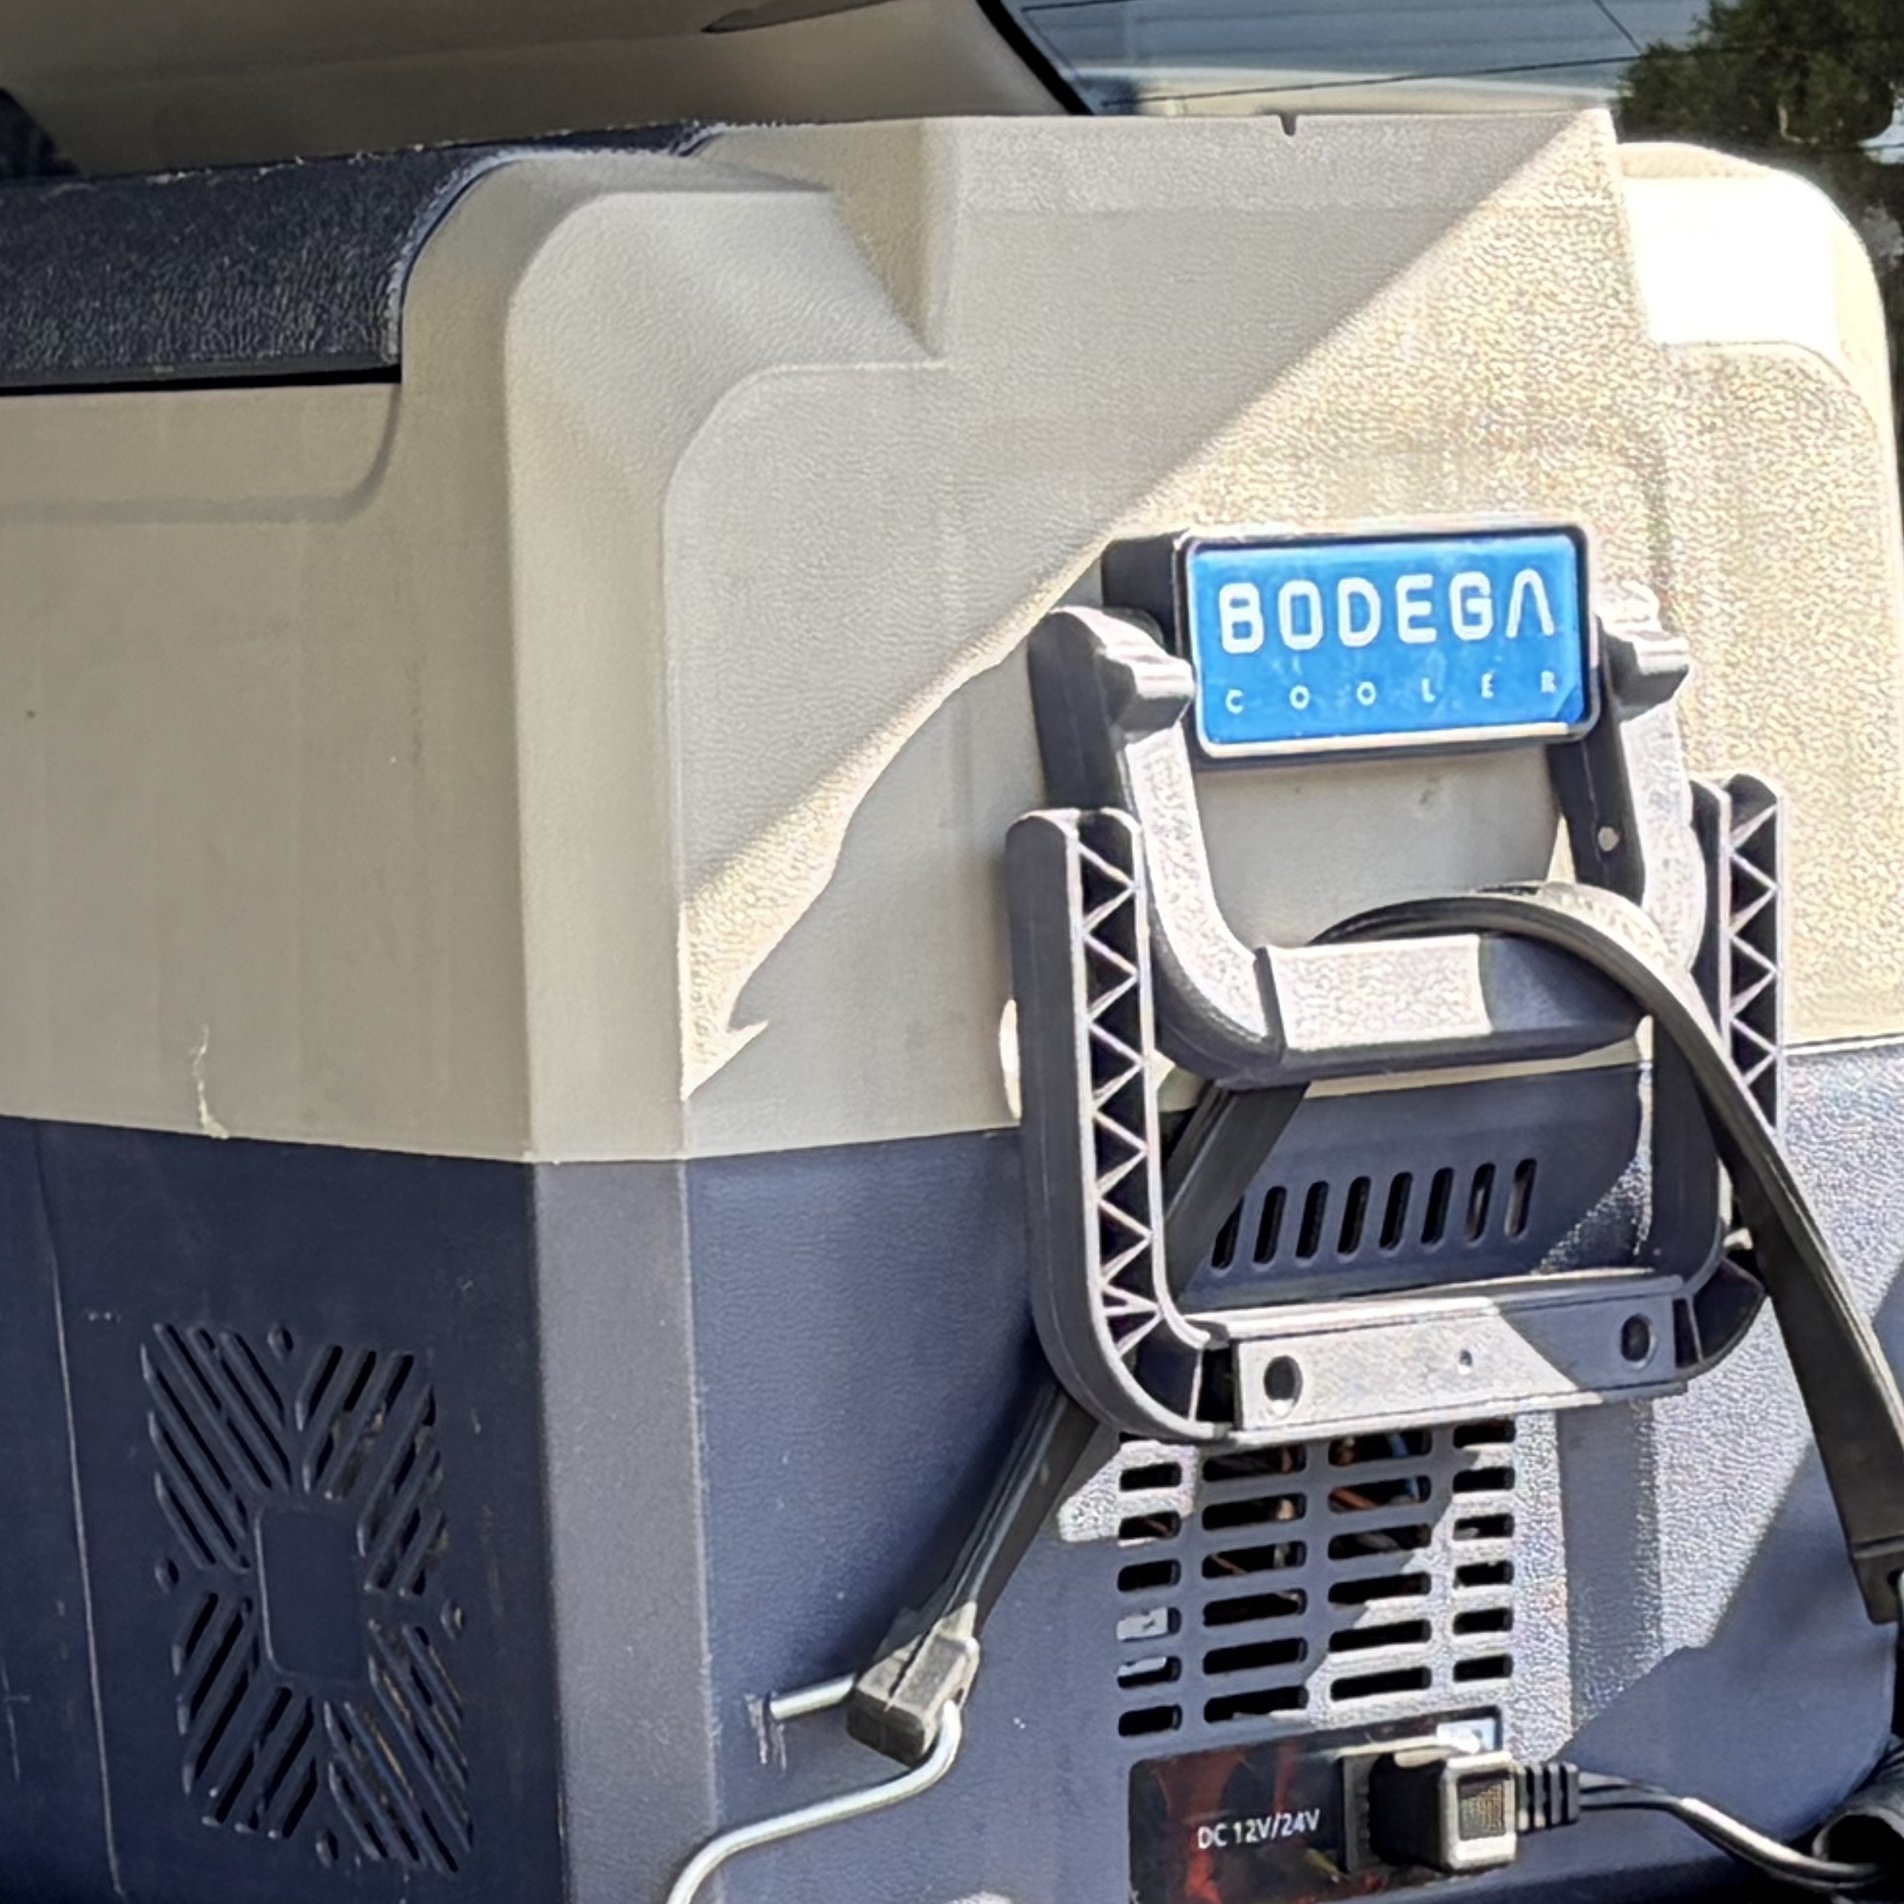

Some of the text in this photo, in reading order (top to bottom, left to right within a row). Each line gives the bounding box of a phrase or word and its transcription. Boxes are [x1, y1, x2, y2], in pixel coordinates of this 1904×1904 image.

[1218, 568, 1554, 654] BODEGA
[1224, 671, 1557, 714] COOLER
[1197, 1808, 1321, 1850] DC 12V/24V
